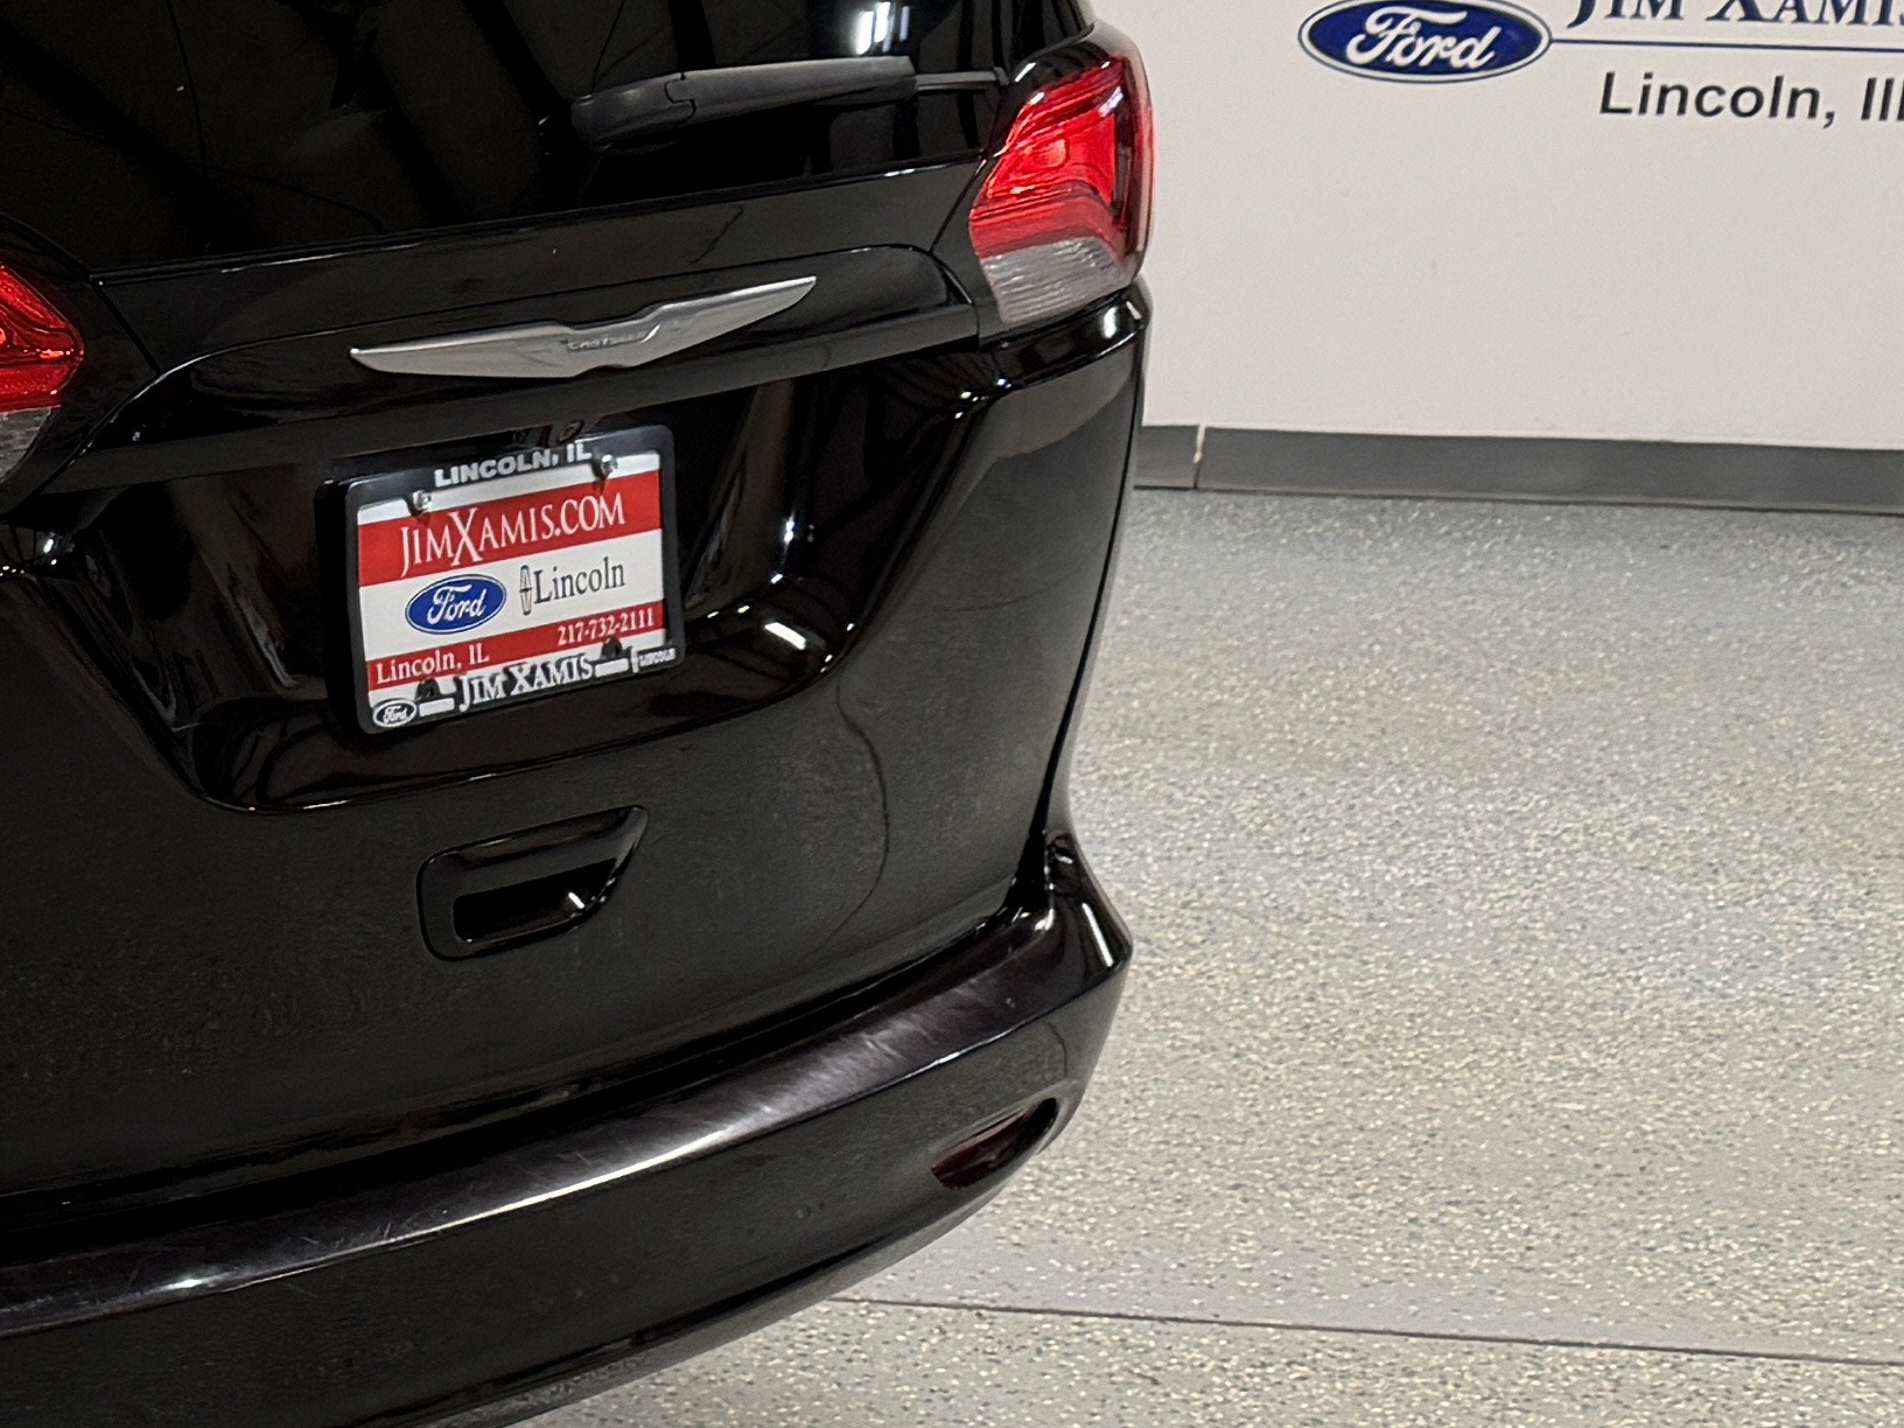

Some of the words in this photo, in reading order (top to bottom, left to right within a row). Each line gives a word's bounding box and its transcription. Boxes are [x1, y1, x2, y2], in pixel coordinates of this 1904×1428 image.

[1345, 6, 1501, 70] Ford
[1600, 72, 1837, 128] Lincoln,
[435, 448, 559, 487] LINCOLN,
[566, 441, 592, 463] IL
[400, 491, 626, 578] JIMXAMIS.COM
[427, 584, 488, 625] Ford
[534, 556, 625, 604] Lincoln
[376, 649, 462, 684] Lincoln,
[468, 642, 490, 665] IL
[458, 672, 508, 712] JIM
[506, 654, 593, 696] XAMIS
